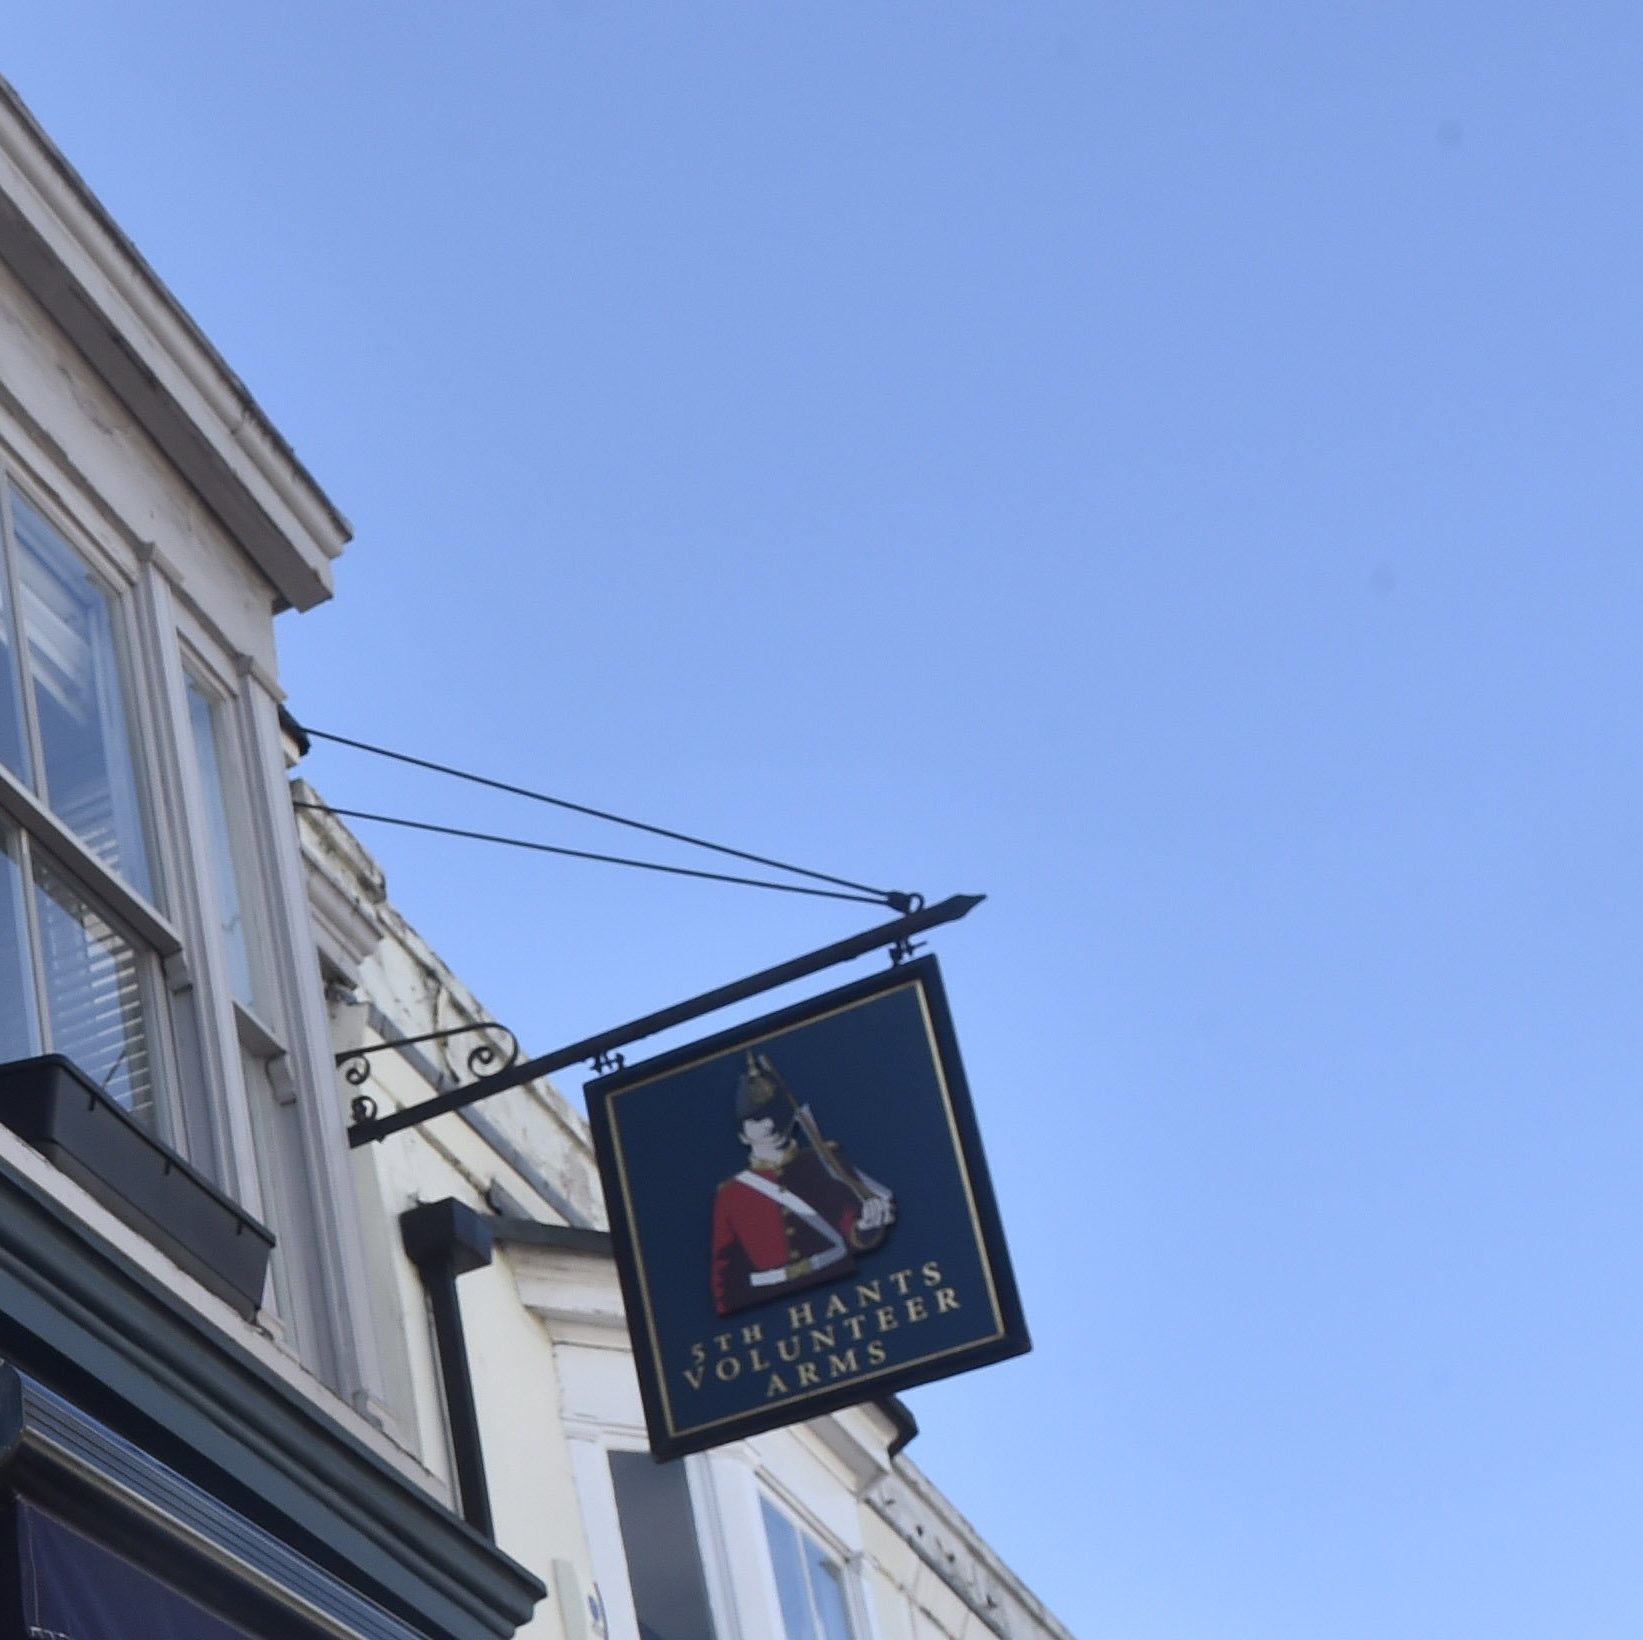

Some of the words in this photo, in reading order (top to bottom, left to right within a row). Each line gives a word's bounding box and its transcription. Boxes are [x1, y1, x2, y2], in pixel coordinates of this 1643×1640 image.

[682, 1286, 962, 1391] VOLUNTEER
[691, 1323, 765, 1364] 5TH
[788, 1260, 944, 1330] HANTS
[766, 1340, 889, 1398] ARMS
